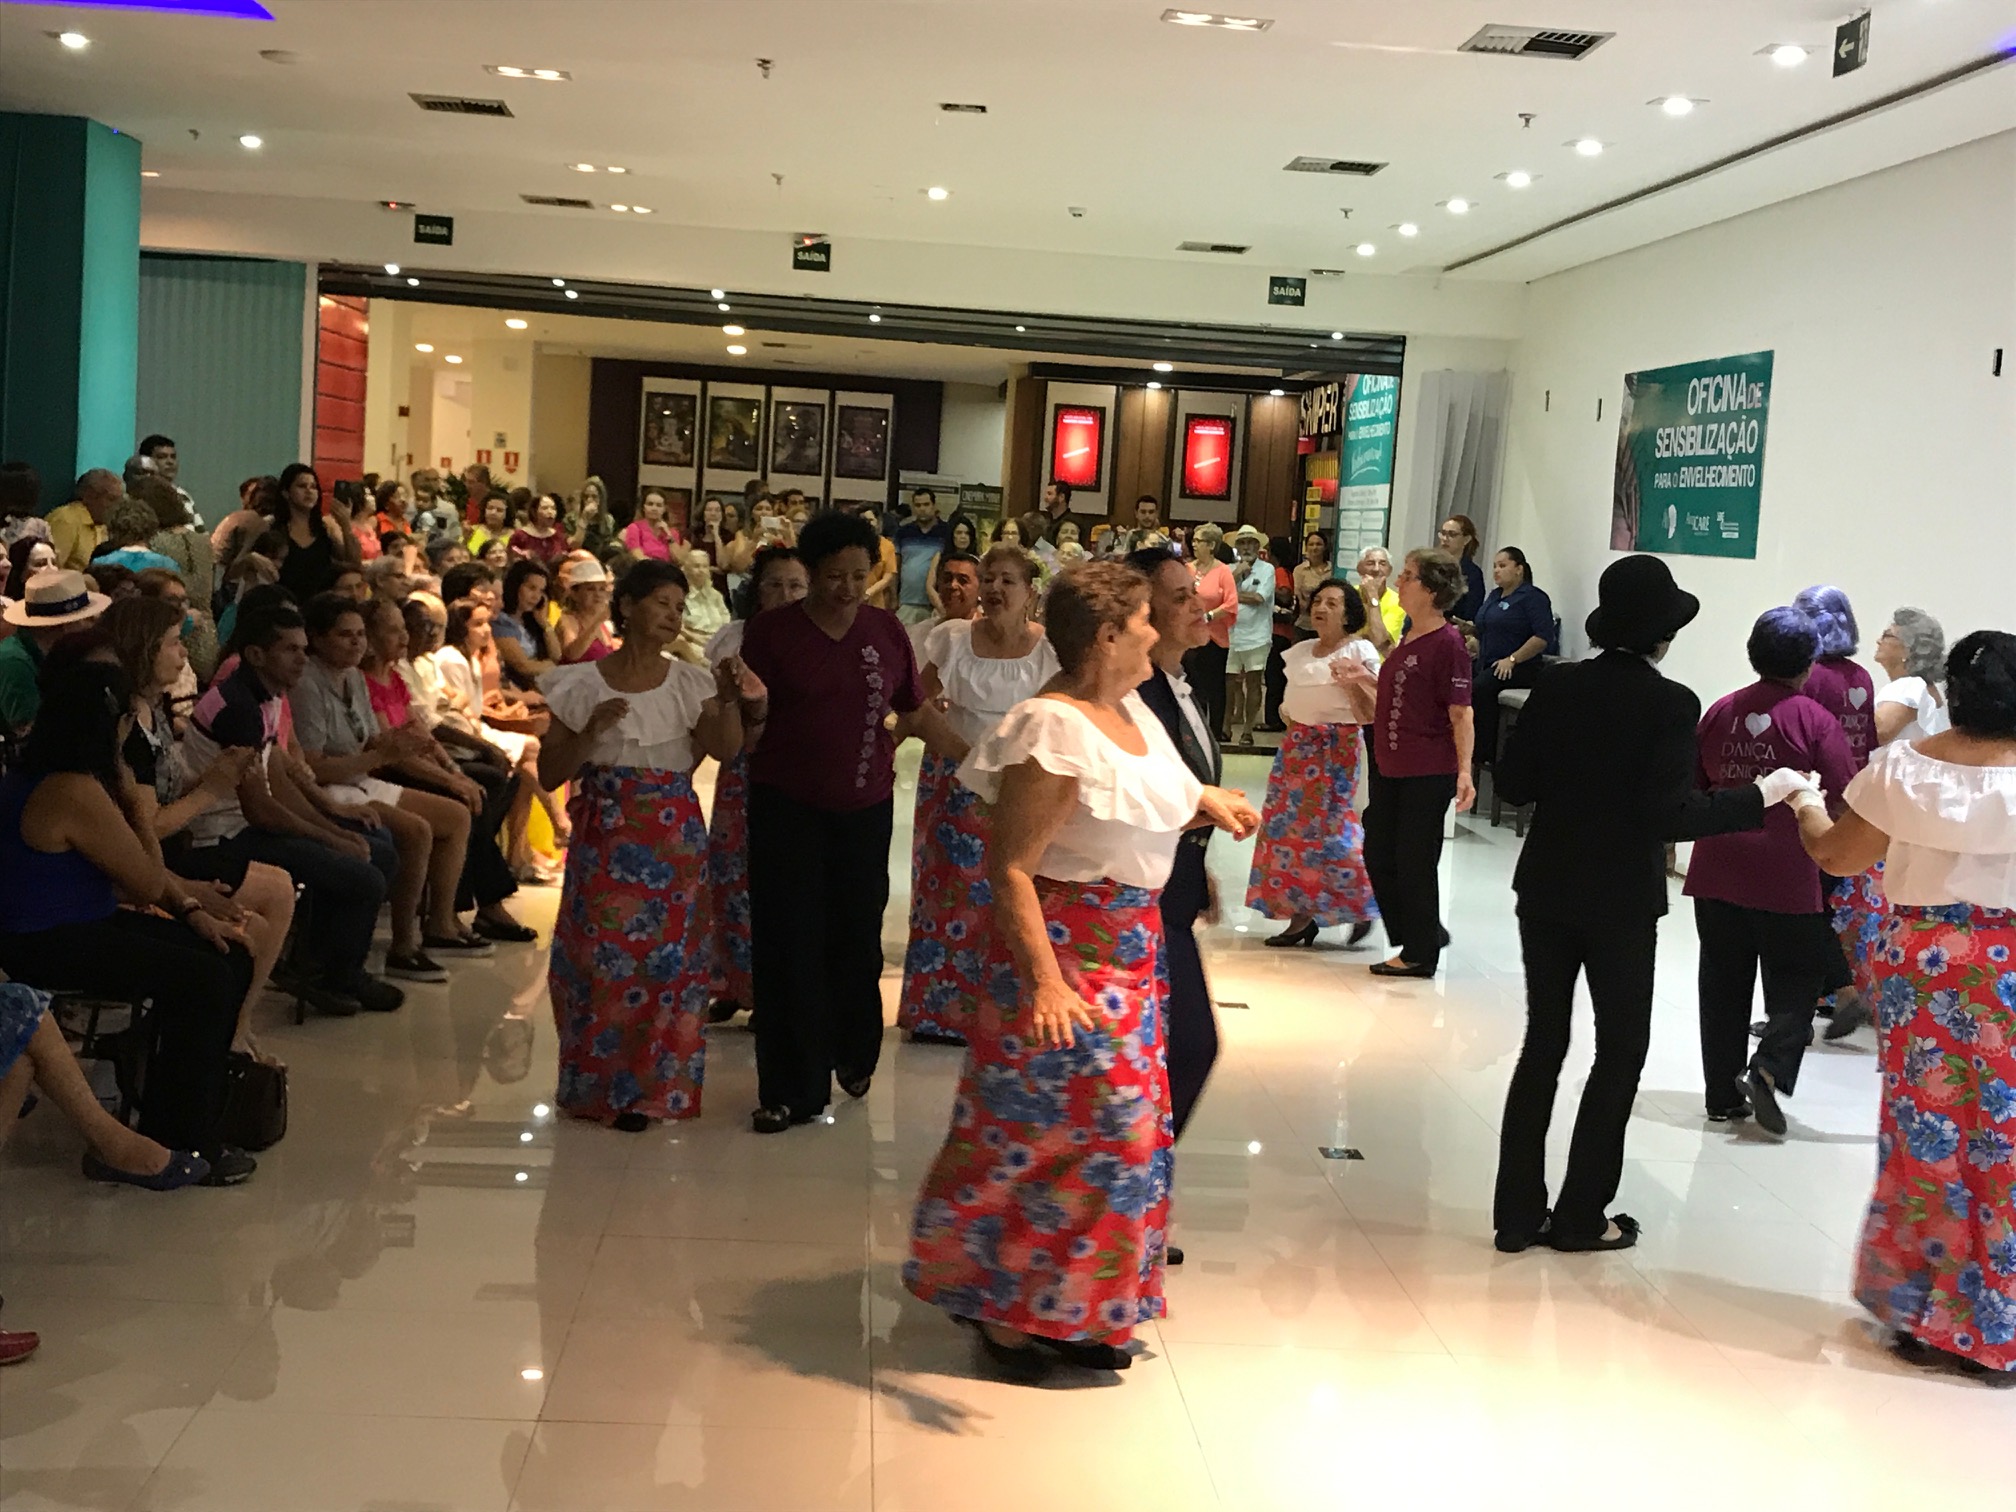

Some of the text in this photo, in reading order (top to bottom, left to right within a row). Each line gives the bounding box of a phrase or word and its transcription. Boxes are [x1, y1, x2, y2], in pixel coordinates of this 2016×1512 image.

[1272, 285, 1302, 297] SAÍDA
[1687, 372, 1765, 416] OFICINA DE
[1655, 414, 1759, 461] SENSIBILIZAÇÃO
[1653, 463, 1756, 489] PARA O ENVELHECIMENTO
[1730, 716, 1739, 735] I
[1721, 742, 1777, 761] DANÇA
